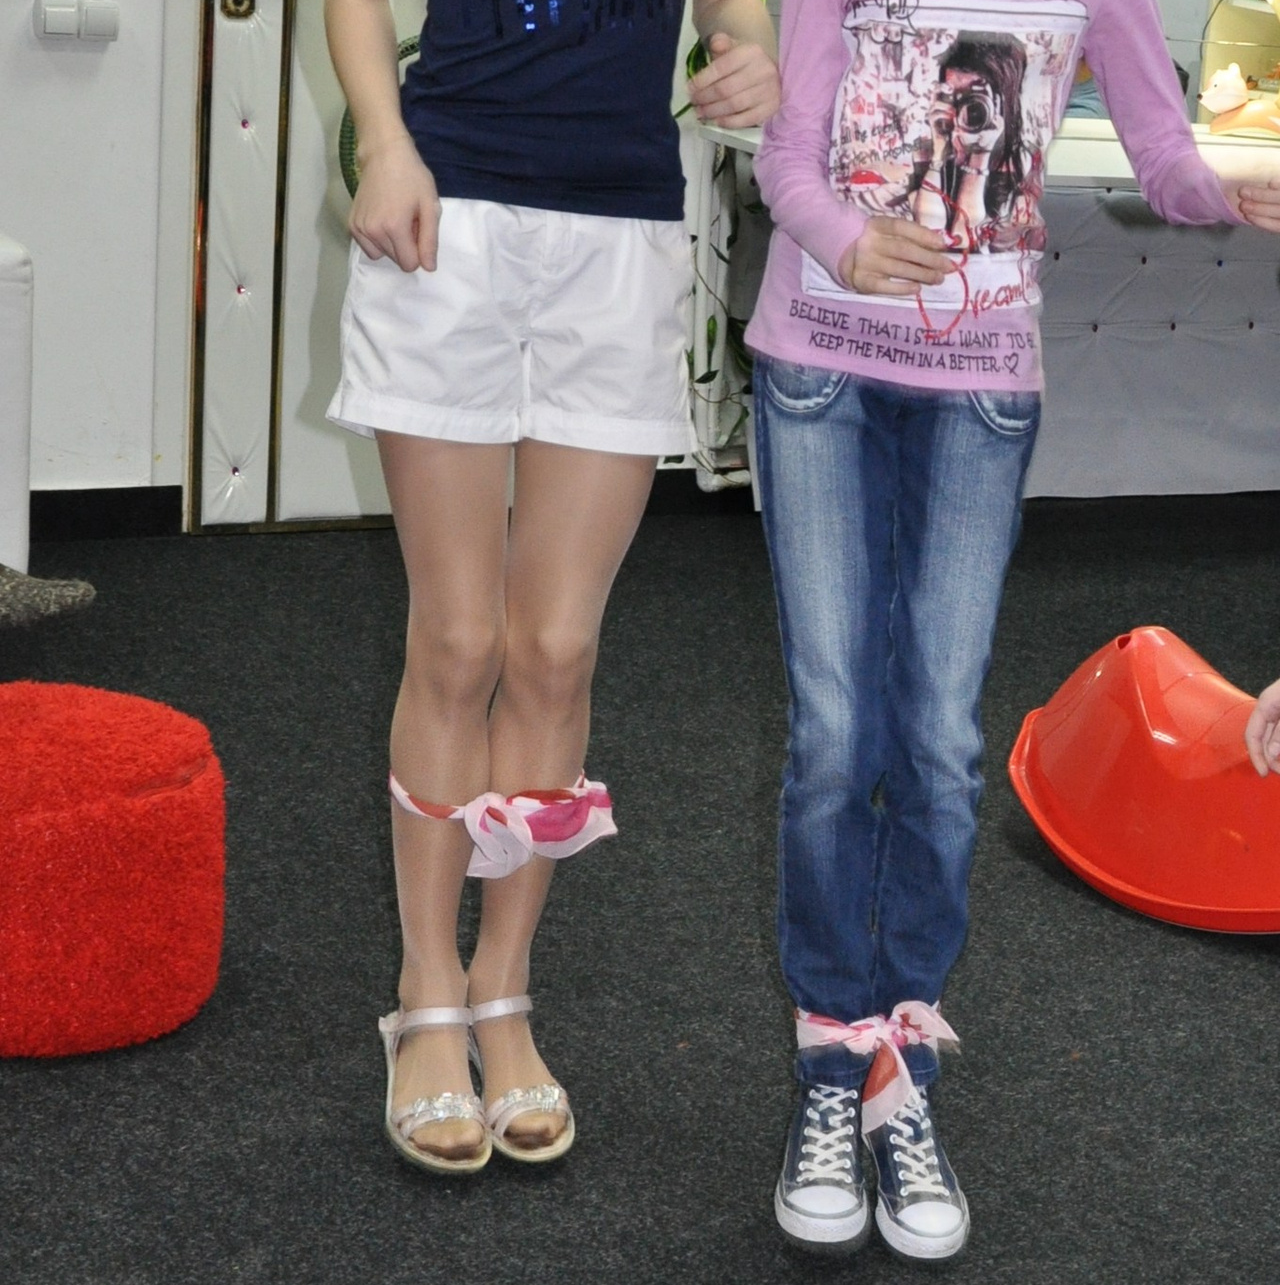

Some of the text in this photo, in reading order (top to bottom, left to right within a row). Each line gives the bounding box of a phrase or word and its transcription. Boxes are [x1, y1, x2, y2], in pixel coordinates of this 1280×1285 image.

[789, 299, 850, 330] BELIEVE
[858, 317, 902, 341] THAT
[904, 325, 910, 343] I
[914, 327, 955, 347] STILL
[959, 330, 1000, 348] WANT
[1007, 332, 1026, 349] TO
[808, 330, 844, 351] KEEP
[847, 339, 873, 358] THE
[876, 344, 915, 366] FAITH
[917, 352, 933, 368] IN
[935, 353, 946, 369] A
